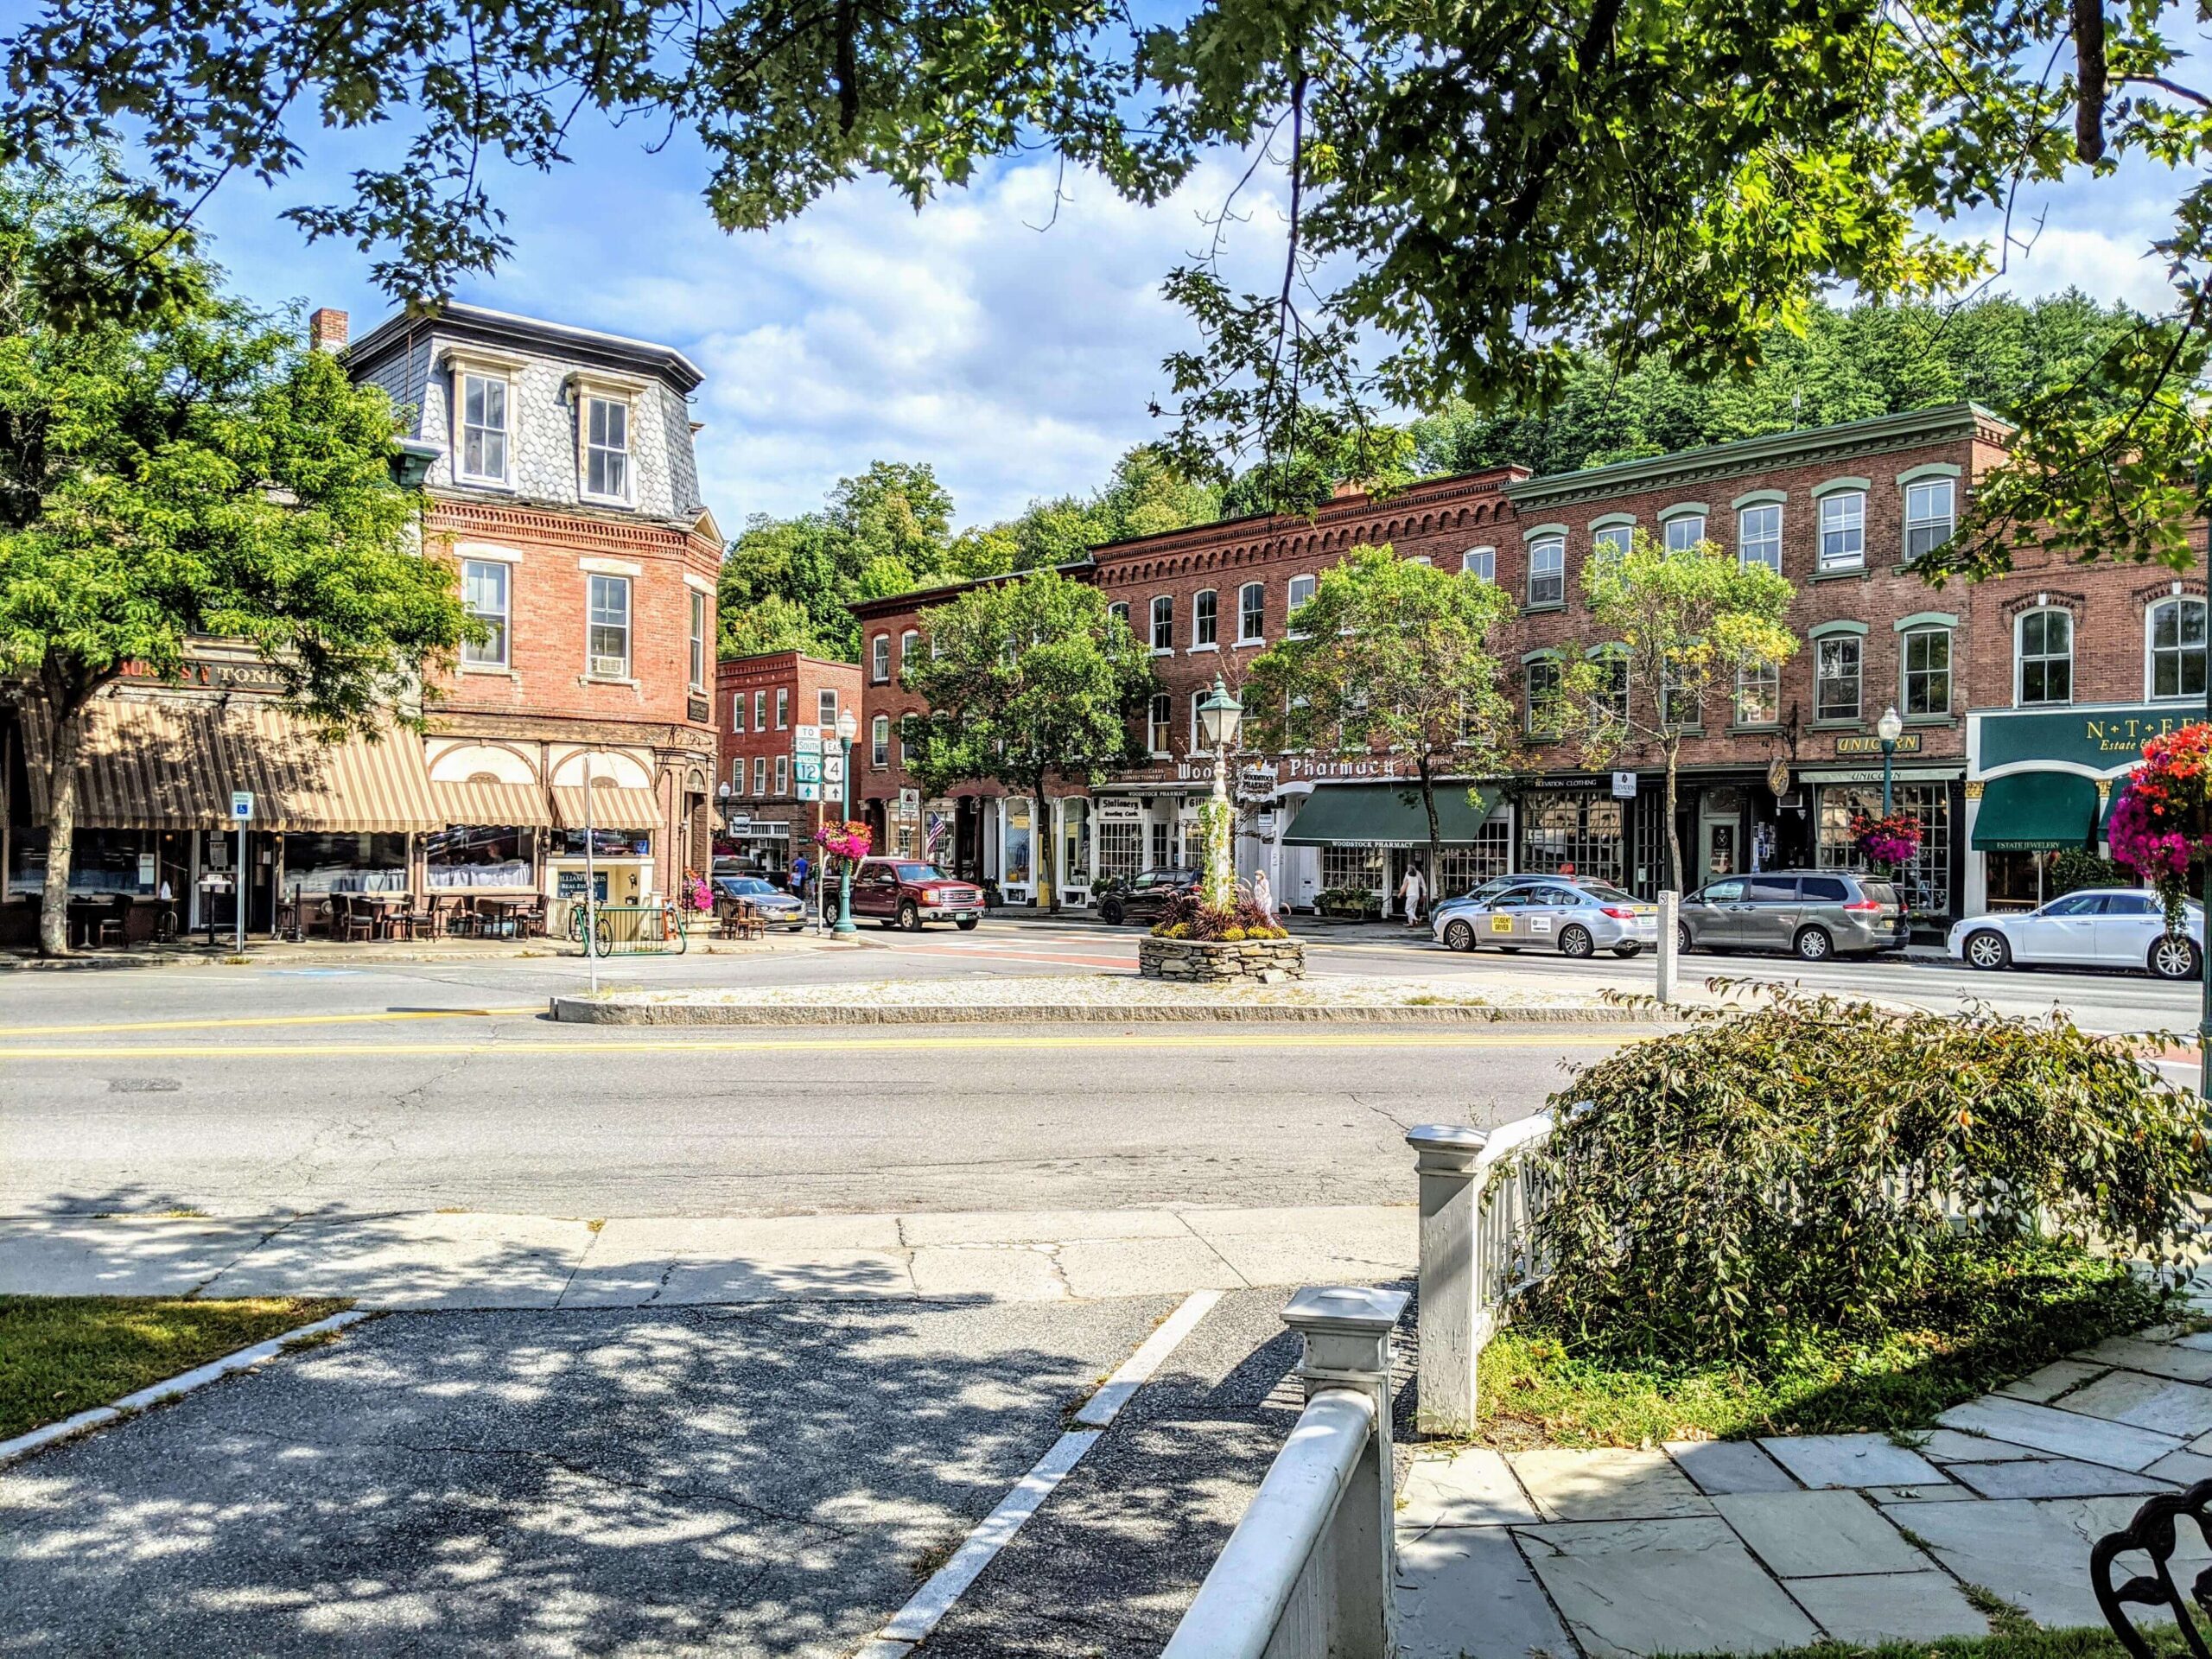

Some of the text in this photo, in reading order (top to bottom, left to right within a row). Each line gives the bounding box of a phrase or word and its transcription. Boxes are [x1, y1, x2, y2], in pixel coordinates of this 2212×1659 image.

[217, 666, 292, 684] TONIC
[798, 741, 819, 751] SOUTH
[828, 743, 842, 752] EAS
[1838, 736, 1916, 752] UNICRN
[2100, 740, 2136, 751] Estate
[802, 765, 816, 779] 12
[830, 762, 839, 776] 4
[1103, 798, 1139, 810] Stationery
